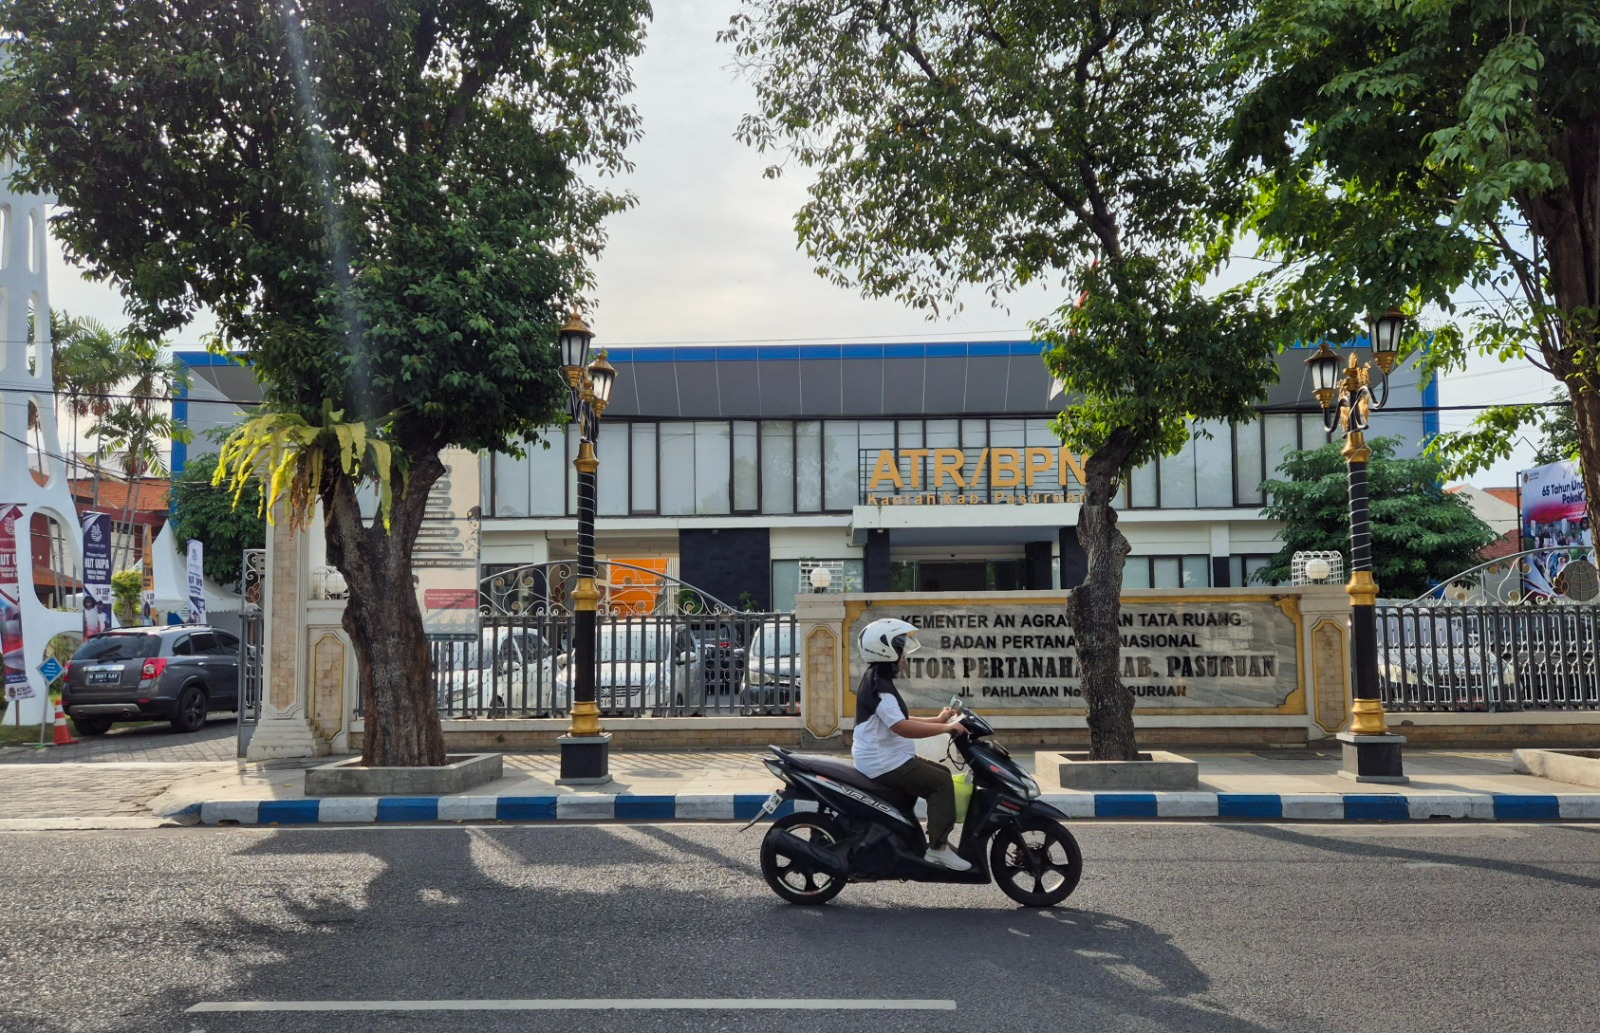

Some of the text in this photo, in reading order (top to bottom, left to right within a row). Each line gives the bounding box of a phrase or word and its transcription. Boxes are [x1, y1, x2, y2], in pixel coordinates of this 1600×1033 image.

[868, 447, 1088, 489] ATR/BPN
[1542, 485, 1550, 497] 65
[1551, 483, 1571, 495] Tahun
[867, 493, 937, 506] Kantah
[942, 492, 987, 505] Kab.
[1020, 614, 1072, 628] AGRA
[1138, 613, 1177, 627] TATA
[1182, 612, 1242, 627] RUANG
[941, 633, 1202, 649] BADAN PERTANA NASIONAL
[963, 656, 1080, 678] PERTANAH
[1166, 654, 1277, 678] PASURUAN
[958, 686, 974, 698] JL
[982, 686, 1059, 698] PAHLAWAN
